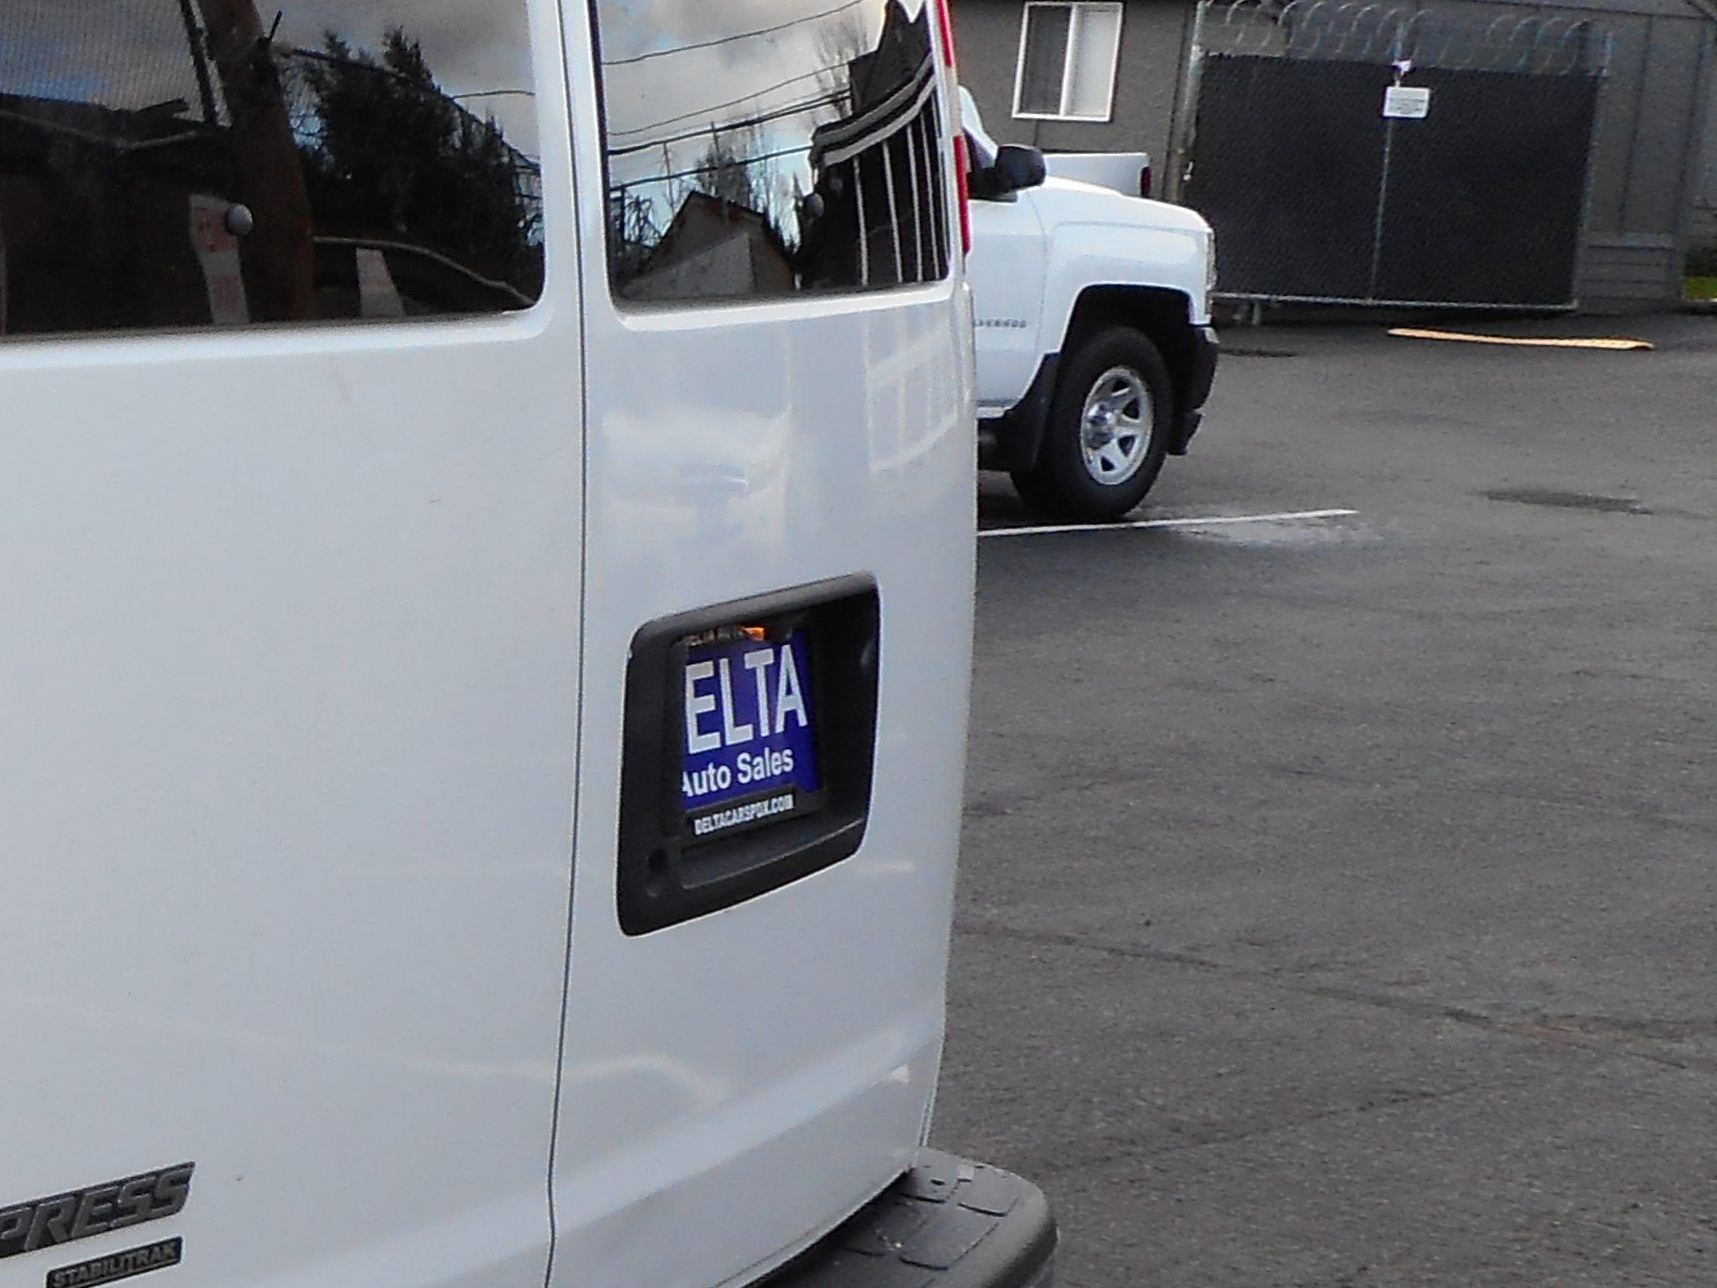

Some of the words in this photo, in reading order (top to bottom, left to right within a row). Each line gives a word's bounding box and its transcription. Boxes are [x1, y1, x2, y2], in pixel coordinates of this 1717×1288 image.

[682, 762, 731, 797] Auto
[737, 747, 794, 784] Sales
[52, 1241, 177, 1288] STABILITRAK
